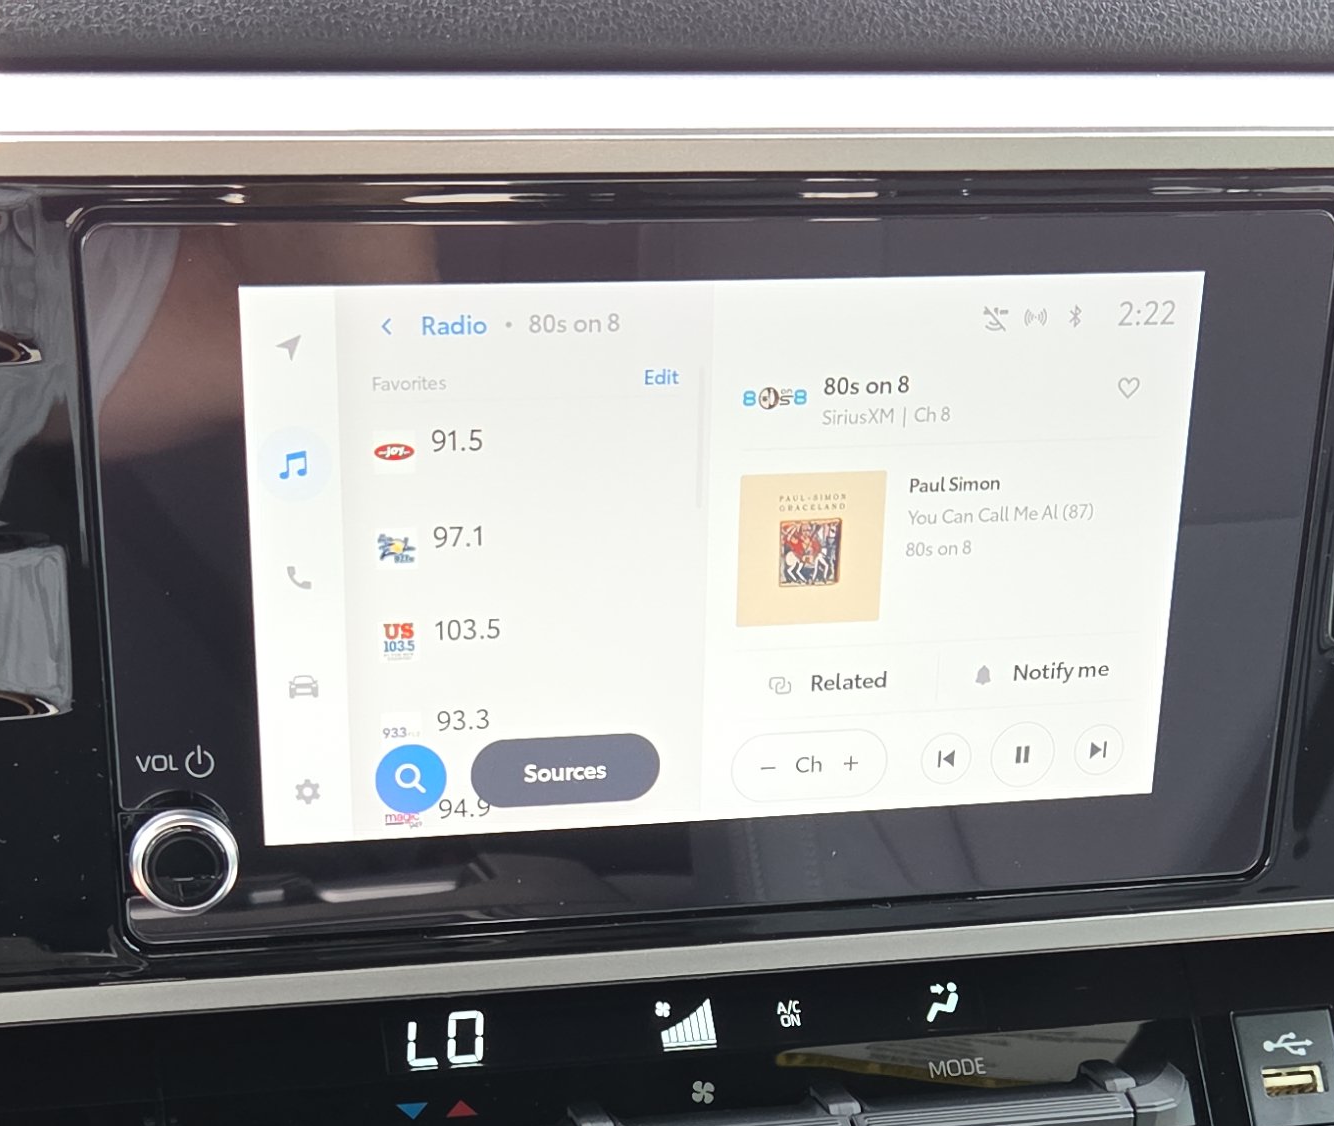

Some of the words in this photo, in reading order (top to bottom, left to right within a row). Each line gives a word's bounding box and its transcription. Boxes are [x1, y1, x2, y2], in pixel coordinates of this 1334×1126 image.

[421, 315, 487, 336] Radio
[529, 314, 567, 334] 80s
[573, 317, 601, 334] on
[607, 313, 620, 333] 8
[1117, 301, 1176, 327] 2:22
[372, 375, 447, 392] Favorites
[644, 368, 679, 386] Edit
[823, 376, 860, 395] 80s
[866, 380, 891, 395] on
[898, 376, 910, 394] 8
[822, 408, 895, 427] SiriusXM
[914, 407, 937, 424] Ch
[941, 406, 951, 422] 8
[431, 429, 483, 453] 91.5
[909, 476, 945, 494] Paul
[949, 475, 1000, 492] Simon
[908, 508, 938, 526] You
[942, 507, 974, 525] Can
[978, 504, 1011, 524] Call
[1014, 505, 1038, 523] Me
[1041, 503, 1059, 521] Al
[1062, 502, 1095, 522] (87)
[433, 525, 483, 549] 97.1
[905, 541, 933, 557] 80s
[937, 543, 959, 557] on
[962, 540, 972, 555] 8
[383, 621, 415, 640] US
[434, 618, 501, 642] 103.5
[811, 671, 888, 693] Related
[1013, 662, 1073, 683] Notify
[1078, 664, 1110, 680] me
[436, 708, 490, 732] 93.3
[135, 754, 179, 773] VOL
[524, 762, 607, 784] Sources
[795, 755, 822, 774] Ch
[438, 798, 491, 820] 94.9
[776, 1000, 802, 1015] A/C
[780, 1013, 802, 1028] ON
[407, 1010, 485, 1068] LO
[927, 1056, 987, 1079] MODE
